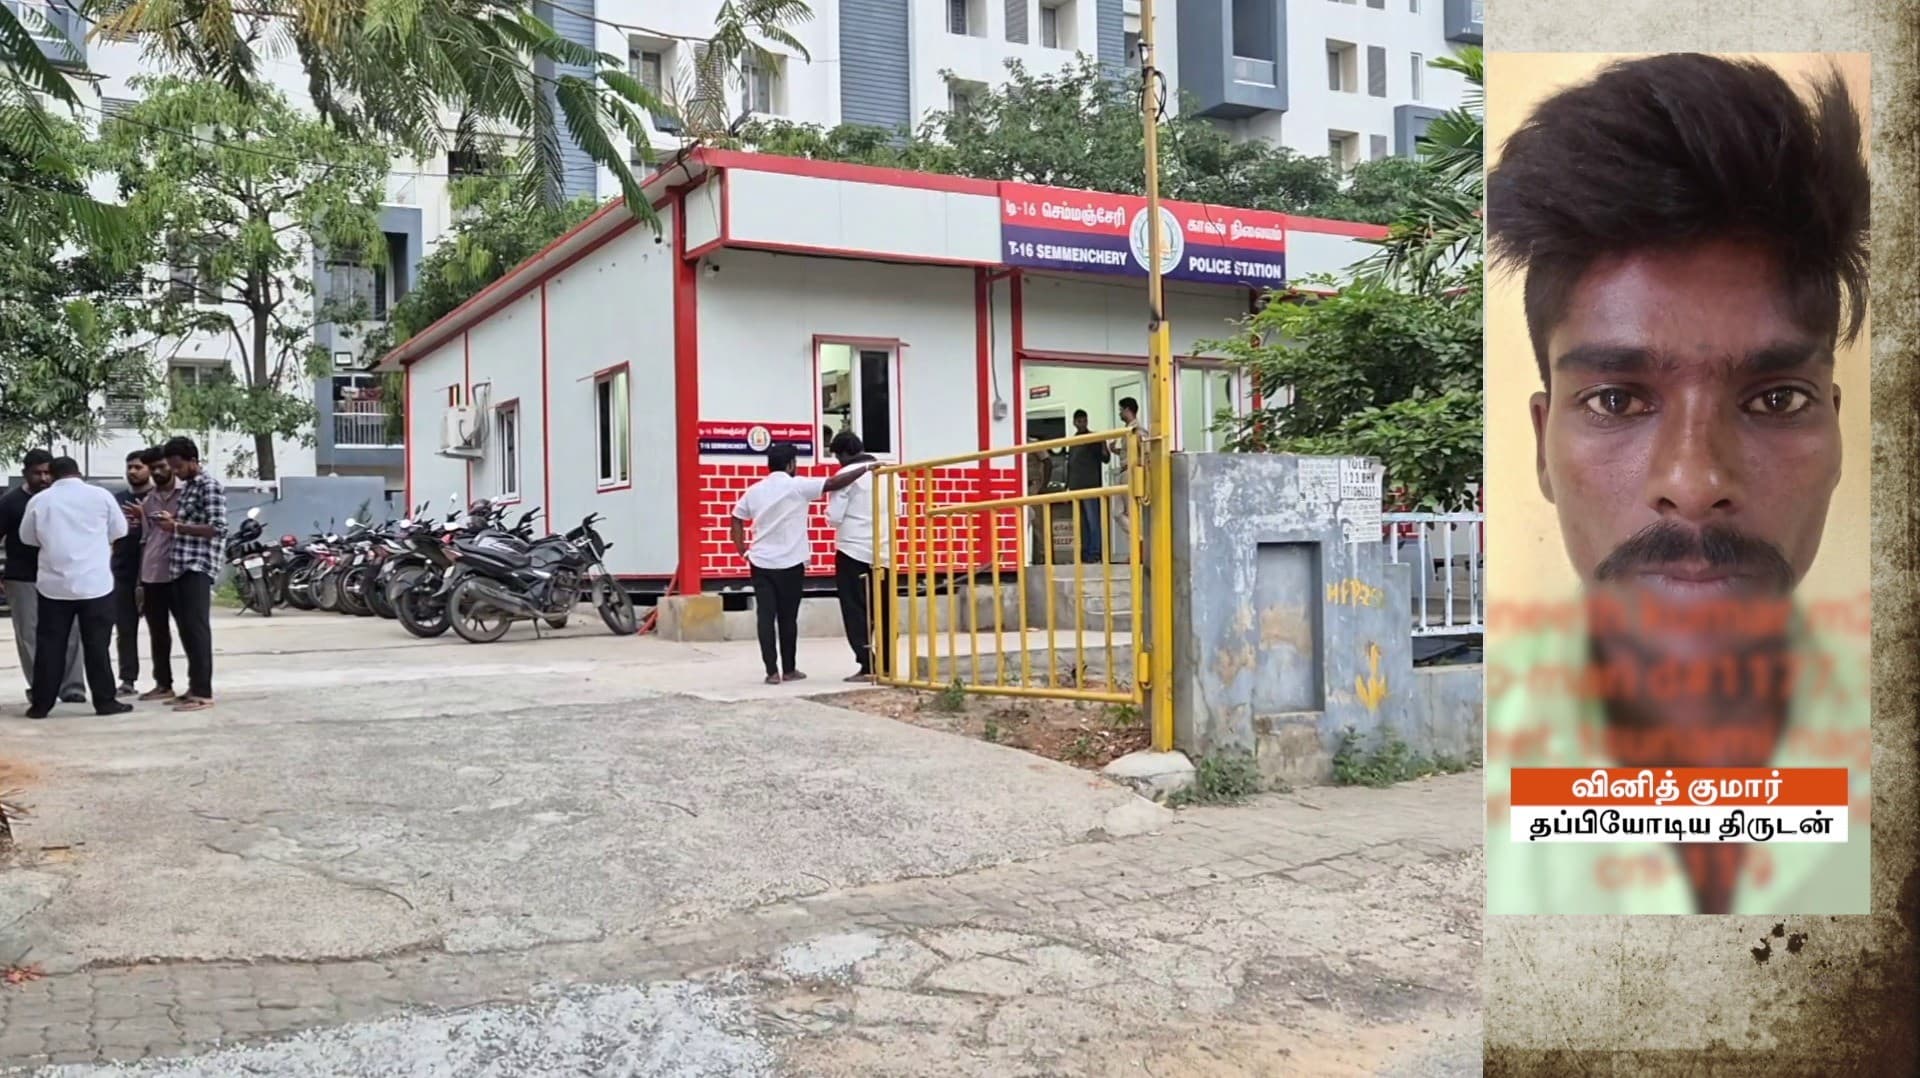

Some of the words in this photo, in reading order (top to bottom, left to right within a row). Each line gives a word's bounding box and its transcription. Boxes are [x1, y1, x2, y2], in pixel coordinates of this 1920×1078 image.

[1187, 218, 1227, 236] காவல்
[1008, 241, 1034, 257] T-16
[1036, 244, 1128, 266] SEMMENCHERY
[1189, 256, 1232, 275] POLICE
[1234, 261, 1282, 279] STATION
